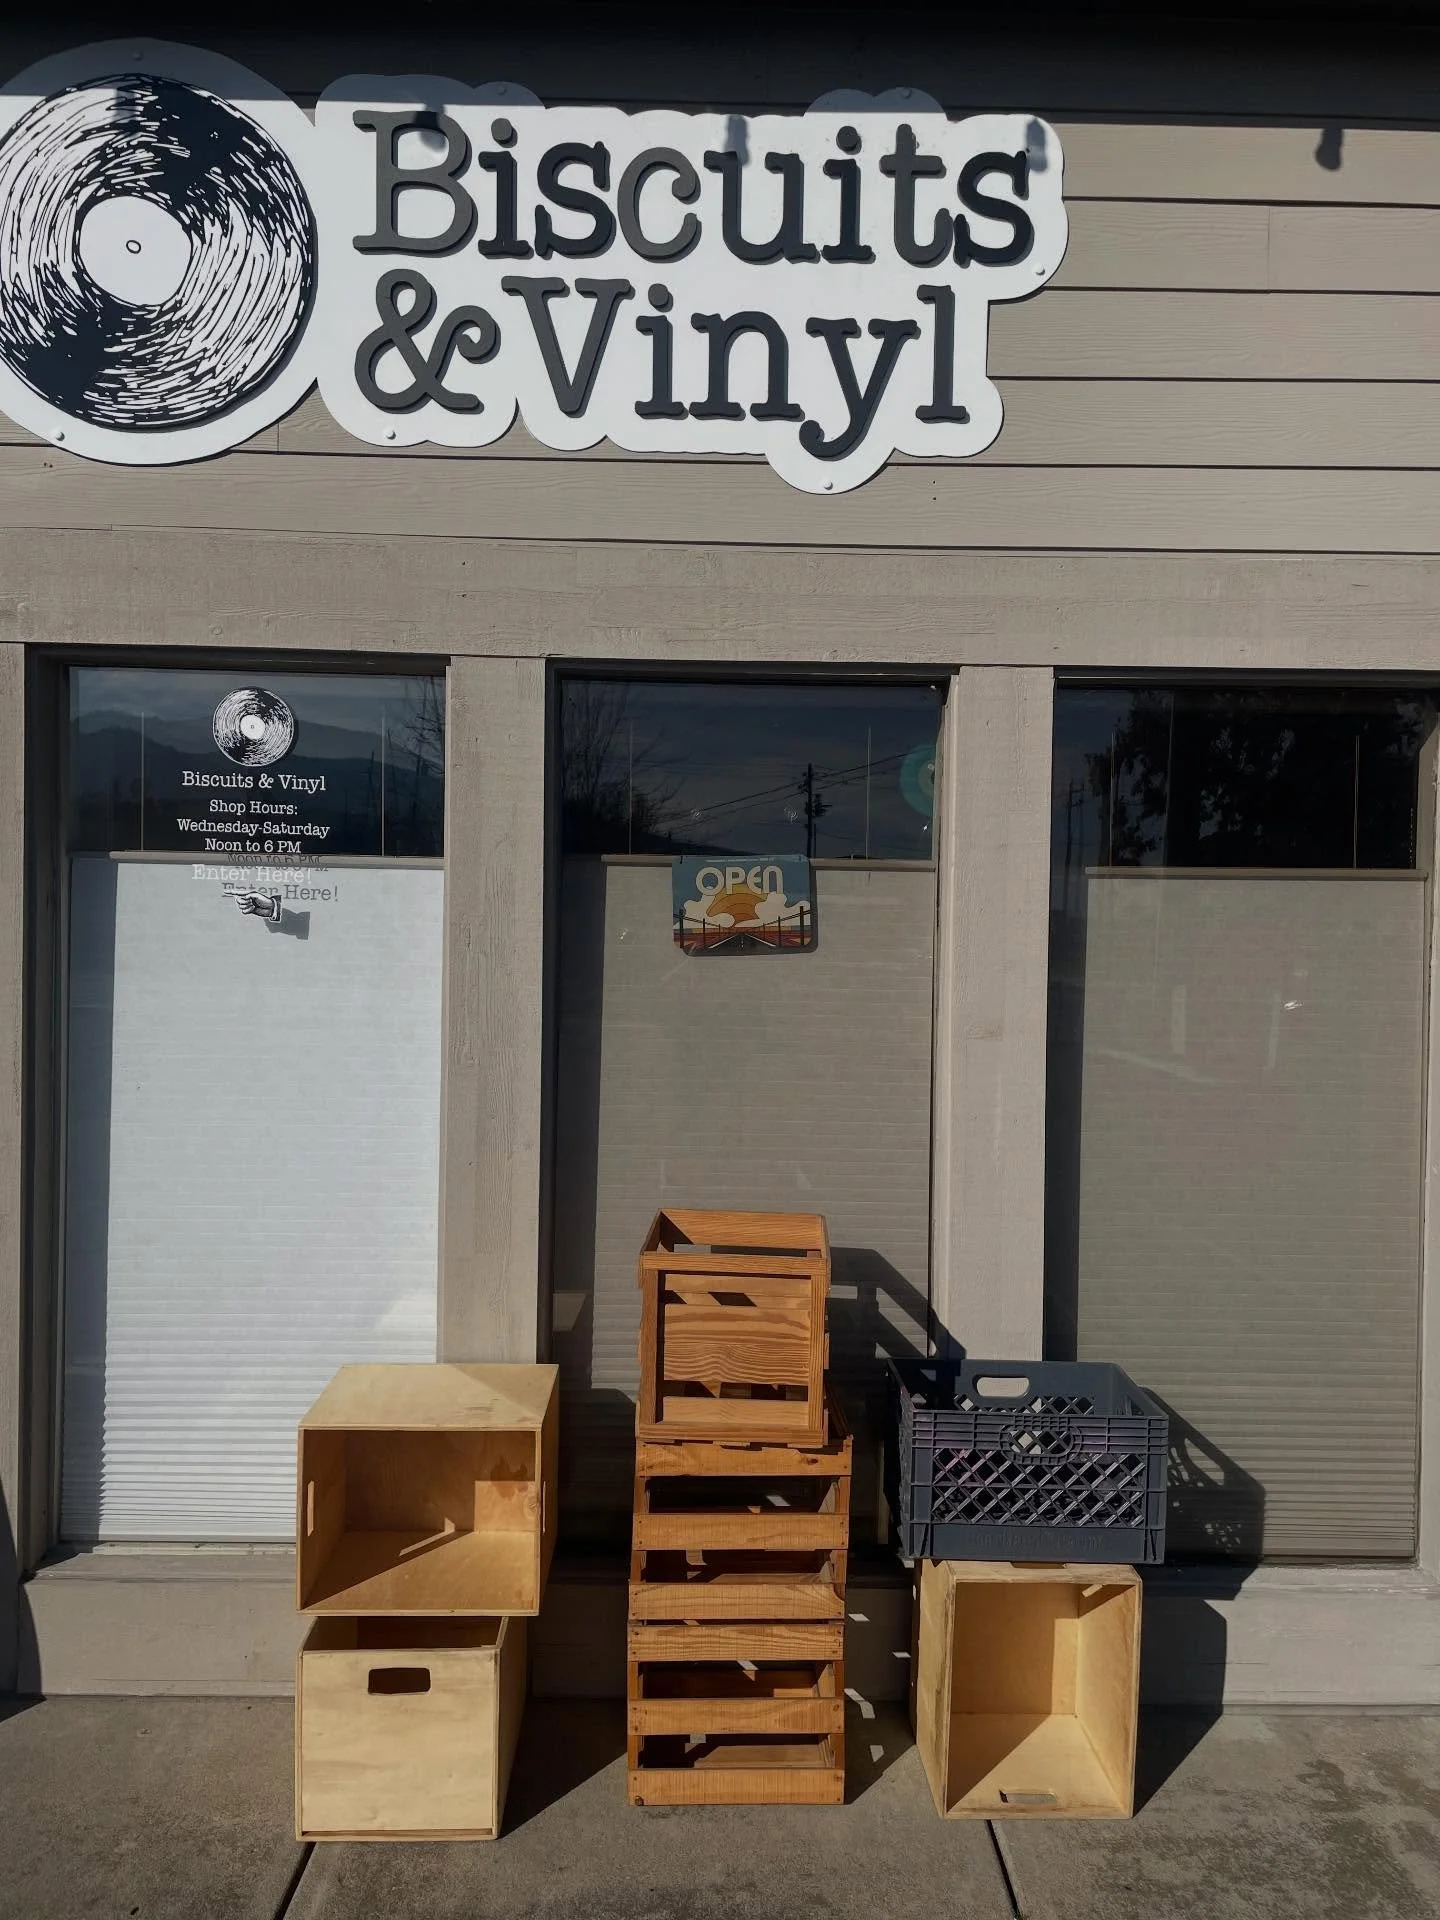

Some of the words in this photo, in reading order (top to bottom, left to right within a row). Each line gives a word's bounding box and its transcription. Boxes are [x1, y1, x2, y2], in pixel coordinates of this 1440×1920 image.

[352, 108, 1035, 266] Biscuits
[182, 771, 254, 788] Biscuits
[258, 773, 274, 789] &
[278, 774, 326, 794] Vinyl
[209, 799, 246, 815] Shop
[250, 801, 298, 815] Hours:
[177, 818, 330, 838] Wednesday-Saturday
[205, 838, 243, 851] Noon
[246, 840, 260, 852] to
[264, 840, 274, 852] 6
[277, 841, 302, 853] PM
[192, 863, 250, 882] Enter
[255, 867, 312, 884] Here!
[695, 865, 784, 895] OPEN
